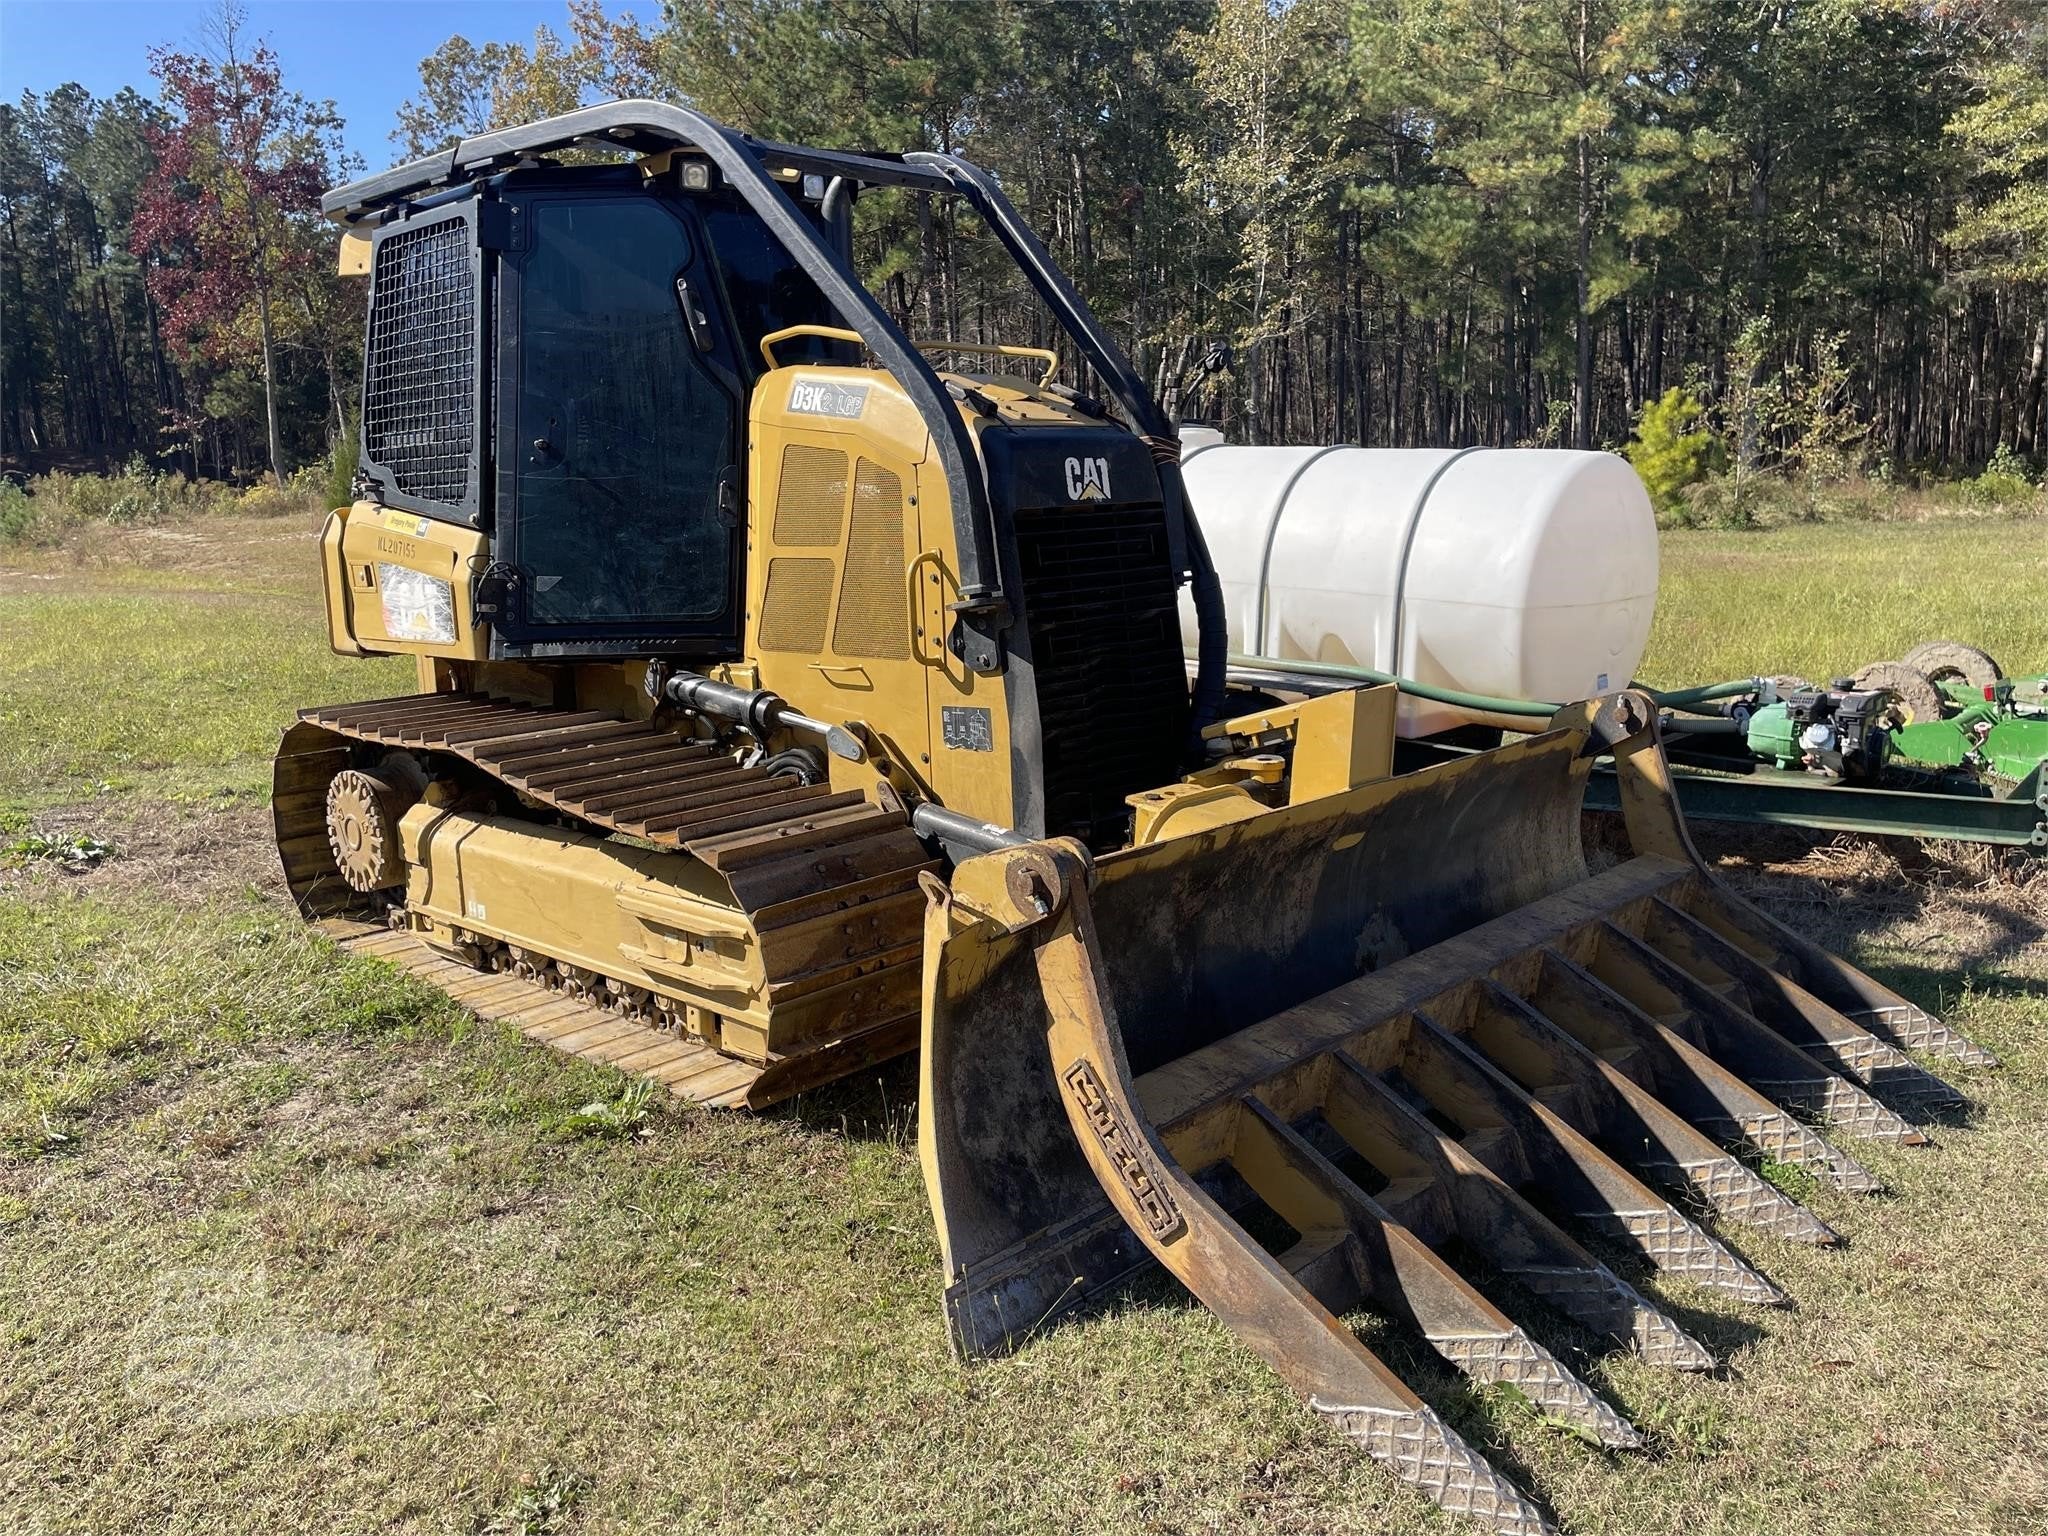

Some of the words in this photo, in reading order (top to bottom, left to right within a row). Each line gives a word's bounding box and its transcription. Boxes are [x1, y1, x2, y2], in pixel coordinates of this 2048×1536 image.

[791, 385, 832, 413] D3K2
[836, 395, 863, 416] LGP
[1064, 456, 1111, 501] CAT
[377, 535, 416, 560] KL207155
